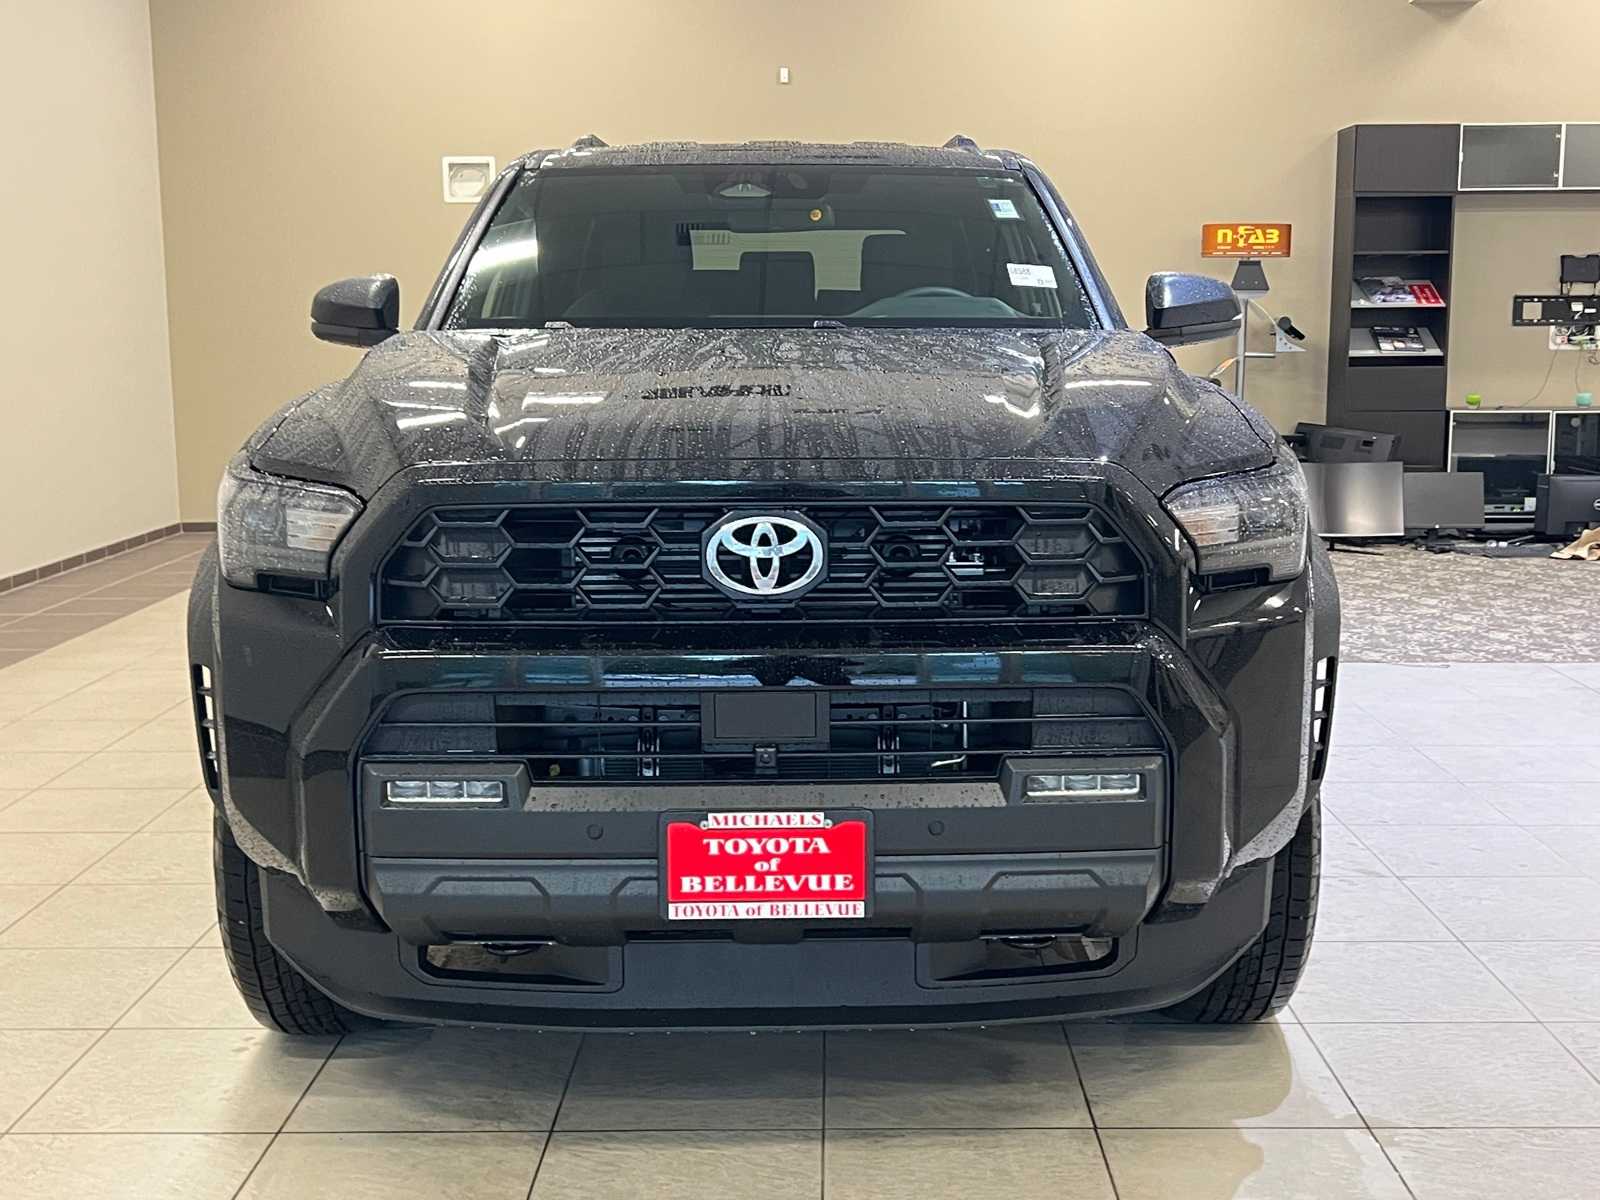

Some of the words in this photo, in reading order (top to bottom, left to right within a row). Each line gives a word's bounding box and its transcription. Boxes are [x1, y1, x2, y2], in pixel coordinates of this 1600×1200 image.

[710, 814, 822, 827] MICHAELS
[702, 837, 831, 856] TOYOTA
[753, 858, 781, 872] of
[679, 874, 855, 893] BELLEVUE
[672, 903, 740, 918] TOYOTA
[745, 903, 764, 917] of
[769, 902, 863, 917] BELLEVUE
